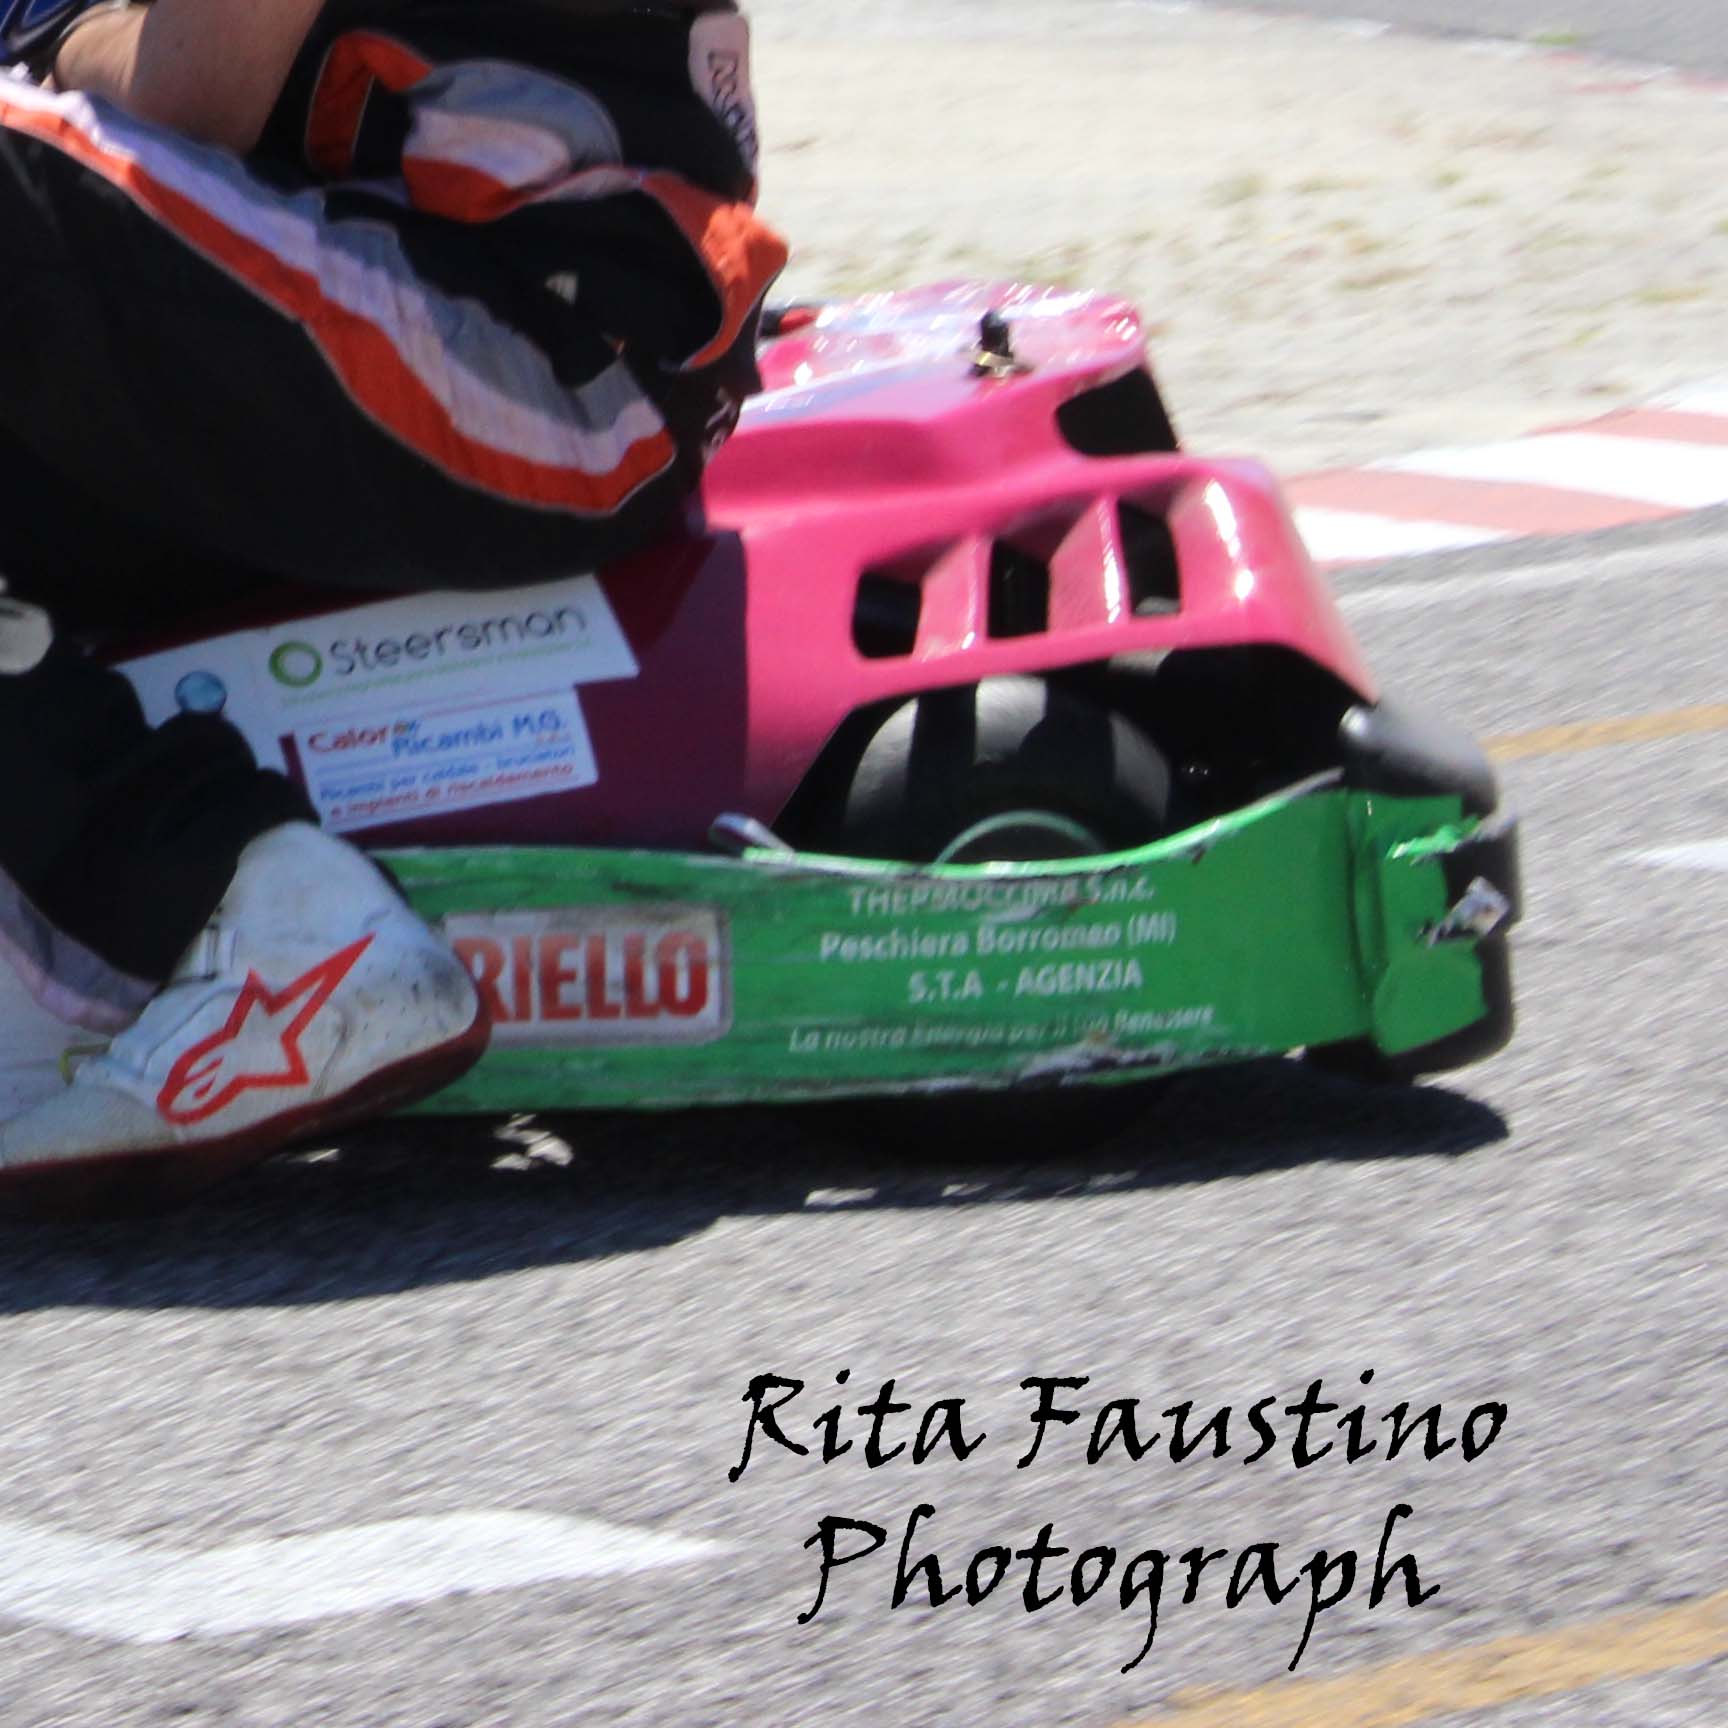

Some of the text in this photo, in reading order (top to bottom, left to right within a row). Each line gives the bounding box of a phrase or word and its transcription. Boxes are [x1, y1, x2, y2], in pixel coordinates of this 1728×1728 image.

[329, 606, 587, 675] Steersman
[309, 723, 388, 752] Calor
[820, 912, 1176, 963] Peschiera Borromeo (MI)
[1014, 959, 1144, 998] AGENZIA
